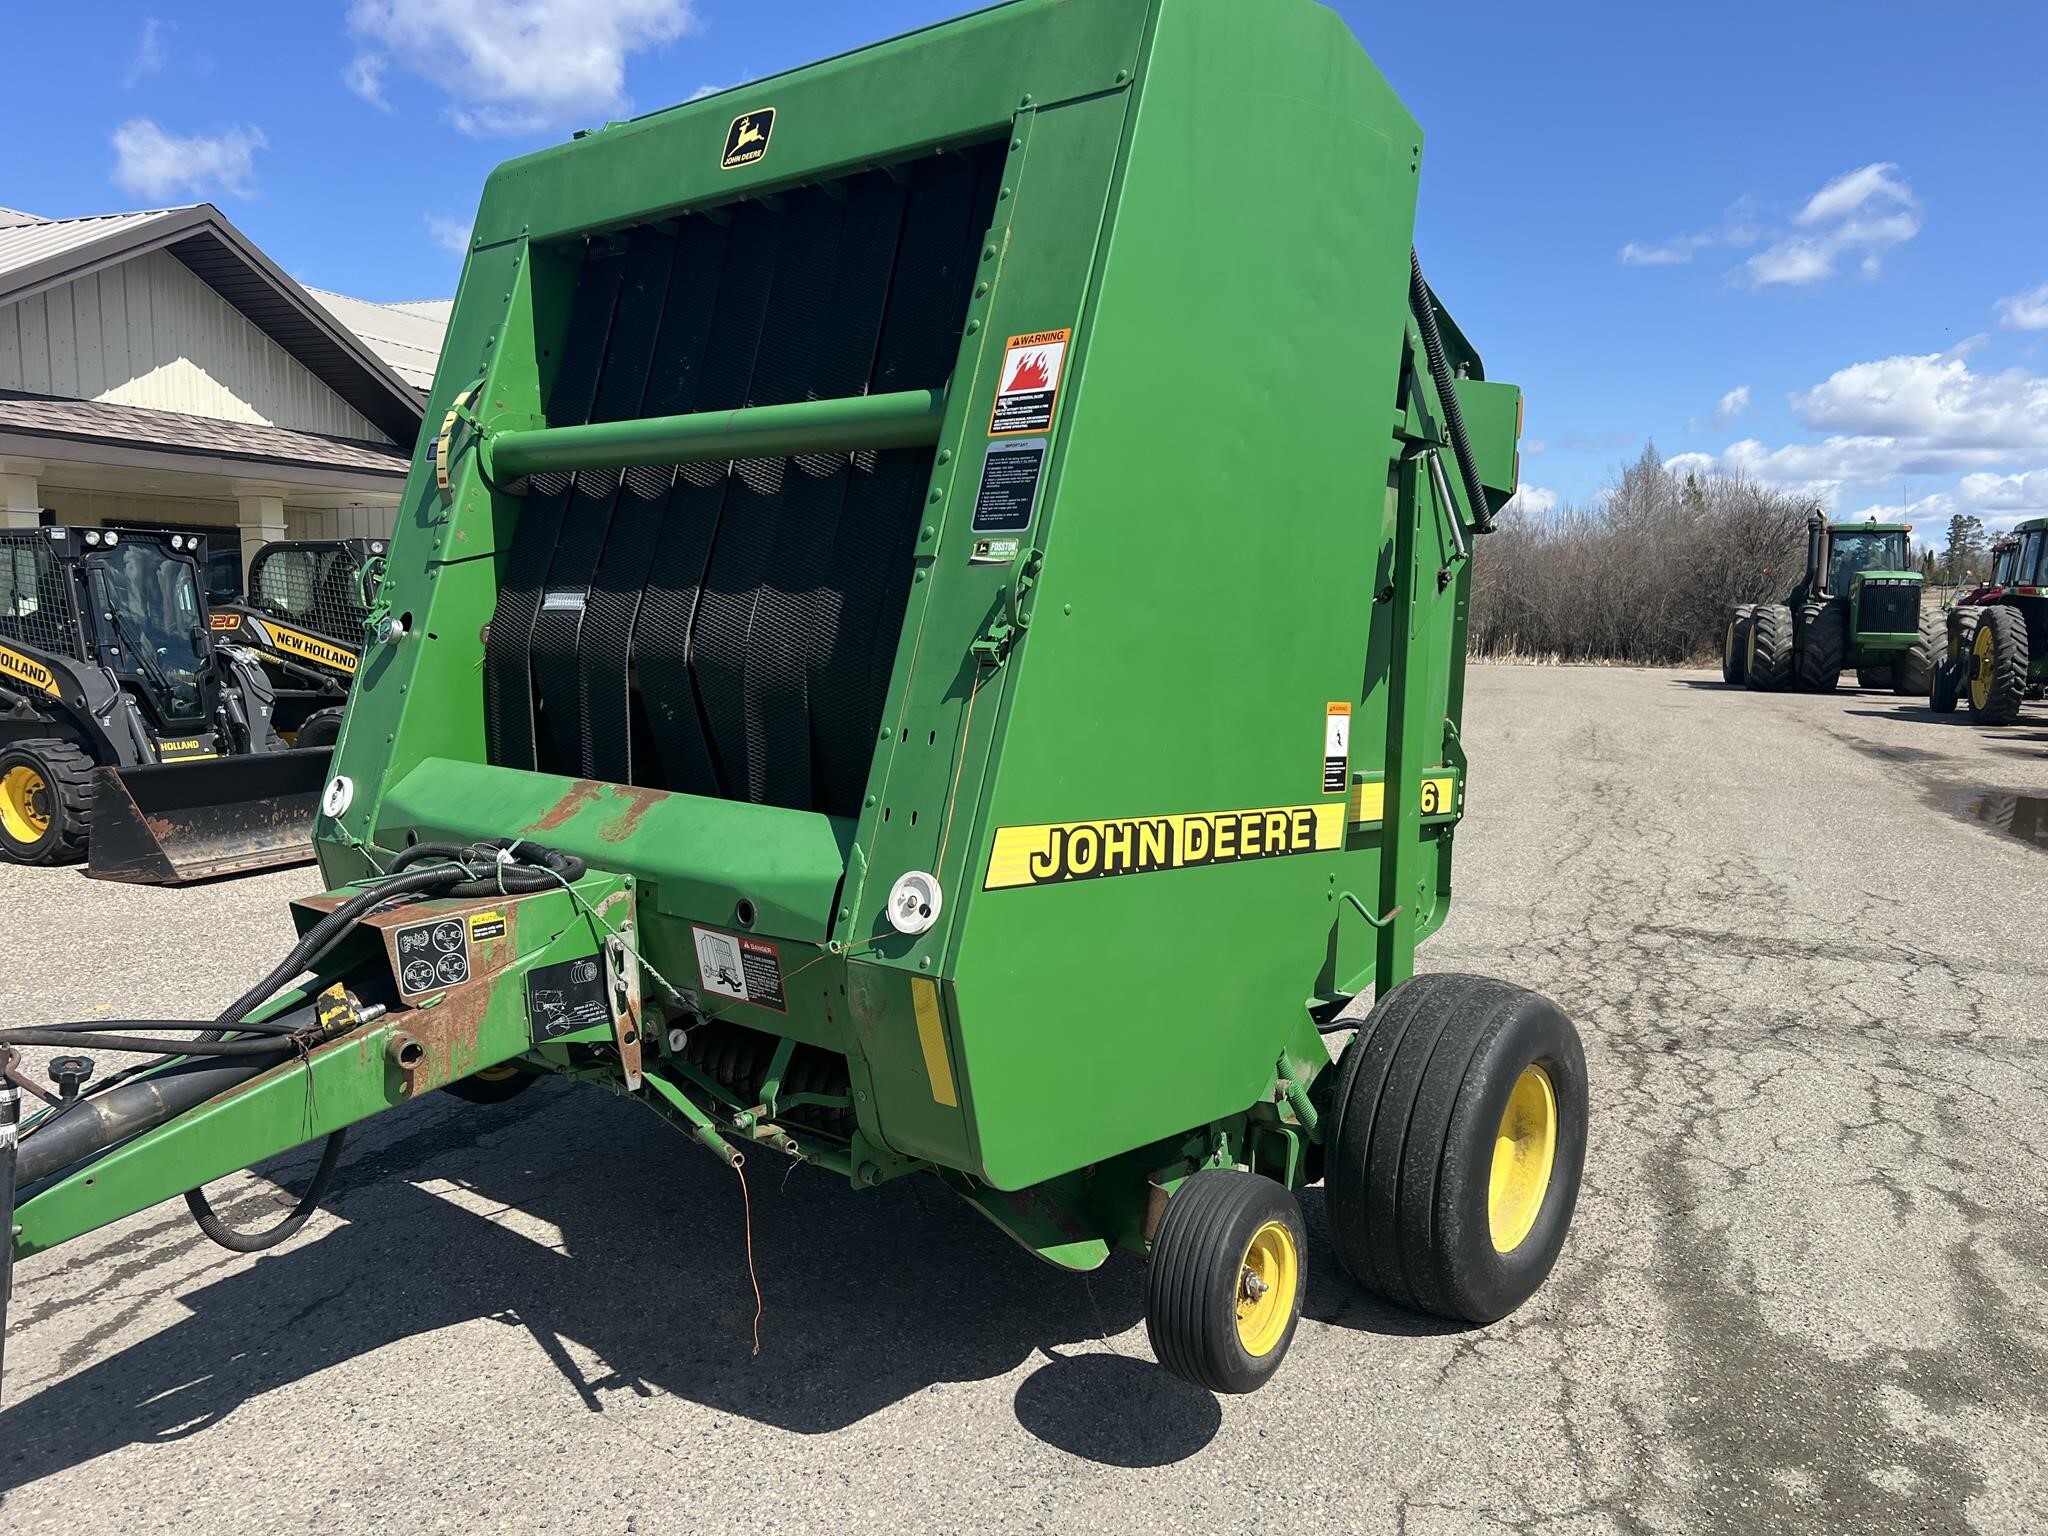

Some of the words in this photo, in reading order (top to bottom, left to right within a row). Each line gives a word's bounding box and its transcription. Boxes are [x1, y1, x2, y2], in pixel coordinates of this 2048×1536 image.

[724, 155, 741, 166] JOHN
[741, 149, 762, 161] DEERE
[1020, 331, 1064, 345] WARNING
[276, 631, 301, 650] NEW
[304, 640, 357, 670] HOLLAND
[0, 651, 47, 683] OLLAND
[160, 740, 199, 752] HOLLAND
[1029, 819, 1172, 882] JOHN
[1182, 808, 1317, 868] DEERE
[750, 943, 772, 954] DANGER
